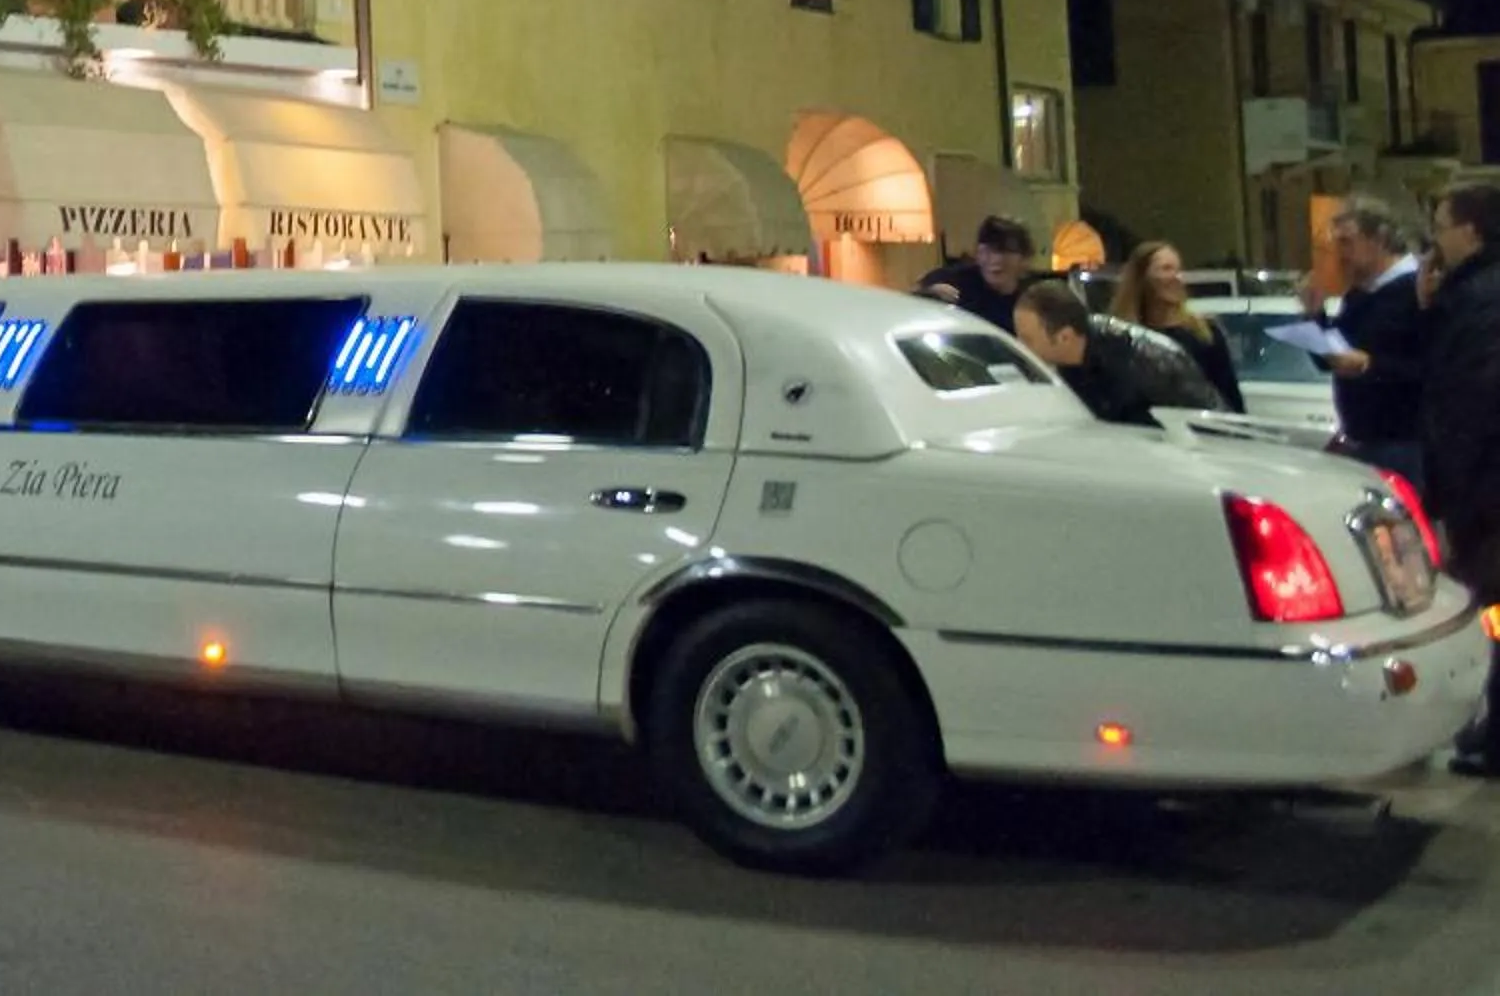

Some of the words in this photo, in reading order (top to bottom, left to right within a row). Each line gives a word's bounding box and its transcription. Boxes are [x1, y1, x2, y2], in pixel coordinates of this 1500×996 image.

[57, 205, 192, 238] PIZZERIA
[269, 210, 411, 244] RISTORANTE
[0, 458, 47, 497] Zia
[53, 460, 123, 501] Piera
